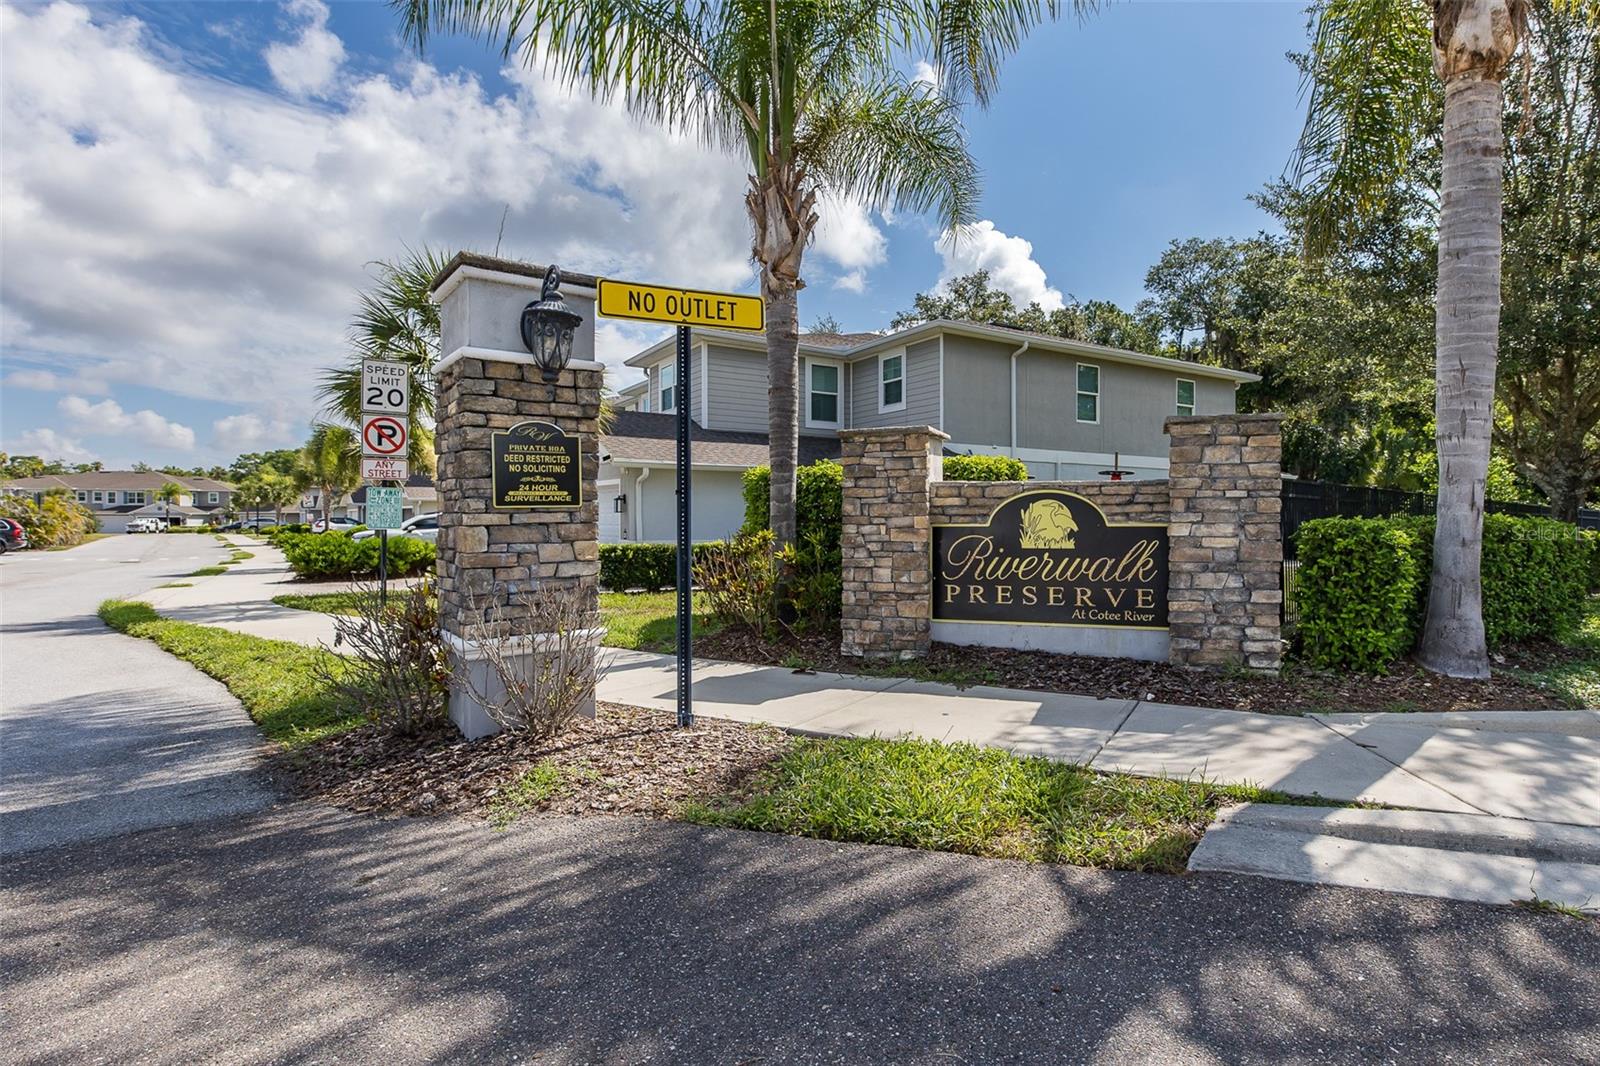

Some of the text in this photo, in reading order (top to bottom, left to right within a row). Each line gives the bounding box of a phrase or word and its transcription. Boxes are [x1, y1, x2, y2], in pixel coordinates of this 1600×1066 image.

[628, 290, 737, 321] NO OUTLET
[366, 365, 406, 377] SPEED
[370, 376, 400, 386] LIMIT
[367, 387, 404, 407] 20
[509, 444, 547, 452] PRIVATE
[504, 454, 571, 463] DEED RESTRICTED
[375, 461, 396, 469] ANY
[509, 464, 567, 473] NO SOLICITING
[368, 470, 402, 478] STREET
[942, 534, 1159, 583] Riverwalk
[944, 584, 1156, 610] PRESERVE
[1072, 609, 1155, 623] At Cotee River
